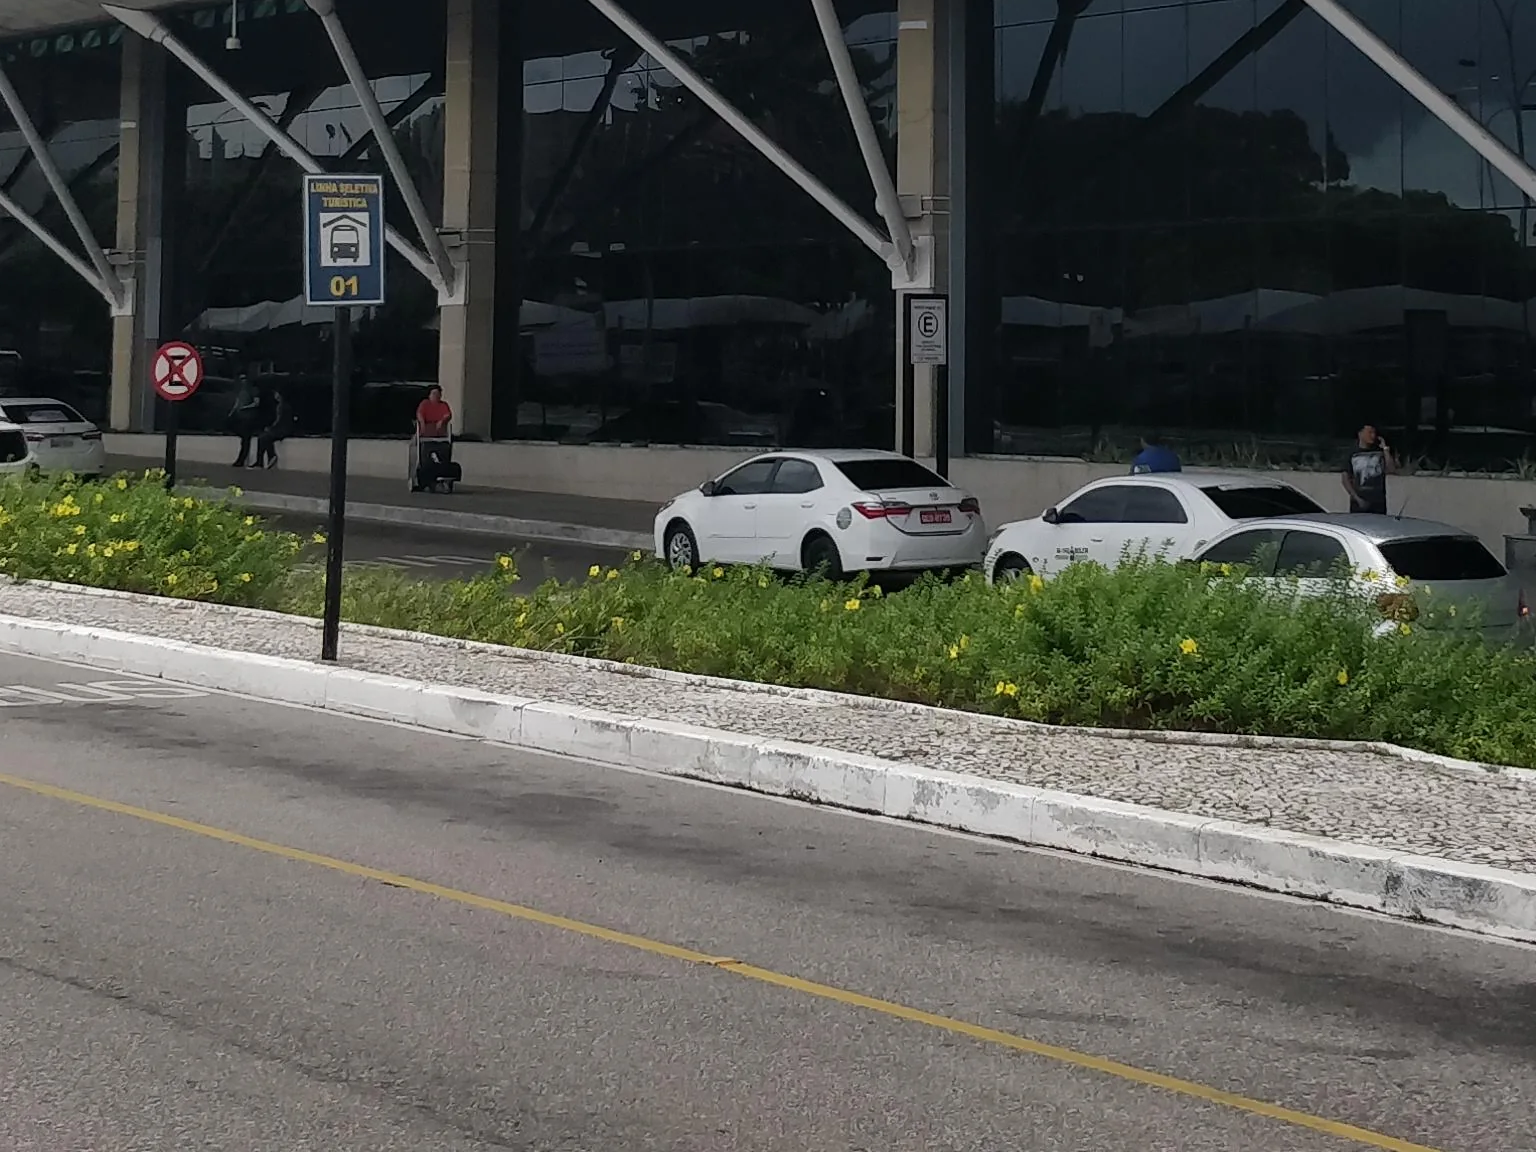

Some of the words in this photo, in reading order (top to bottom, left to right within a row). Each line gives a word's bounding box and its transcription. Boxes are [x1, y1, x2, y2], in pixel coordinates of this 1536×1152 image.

[311, 182, 338, 193] LINHA
[338, 183, 378, 194] SELETIVA
[330, 275, 359, 296] 01
[923, 316, 934, 333] E
